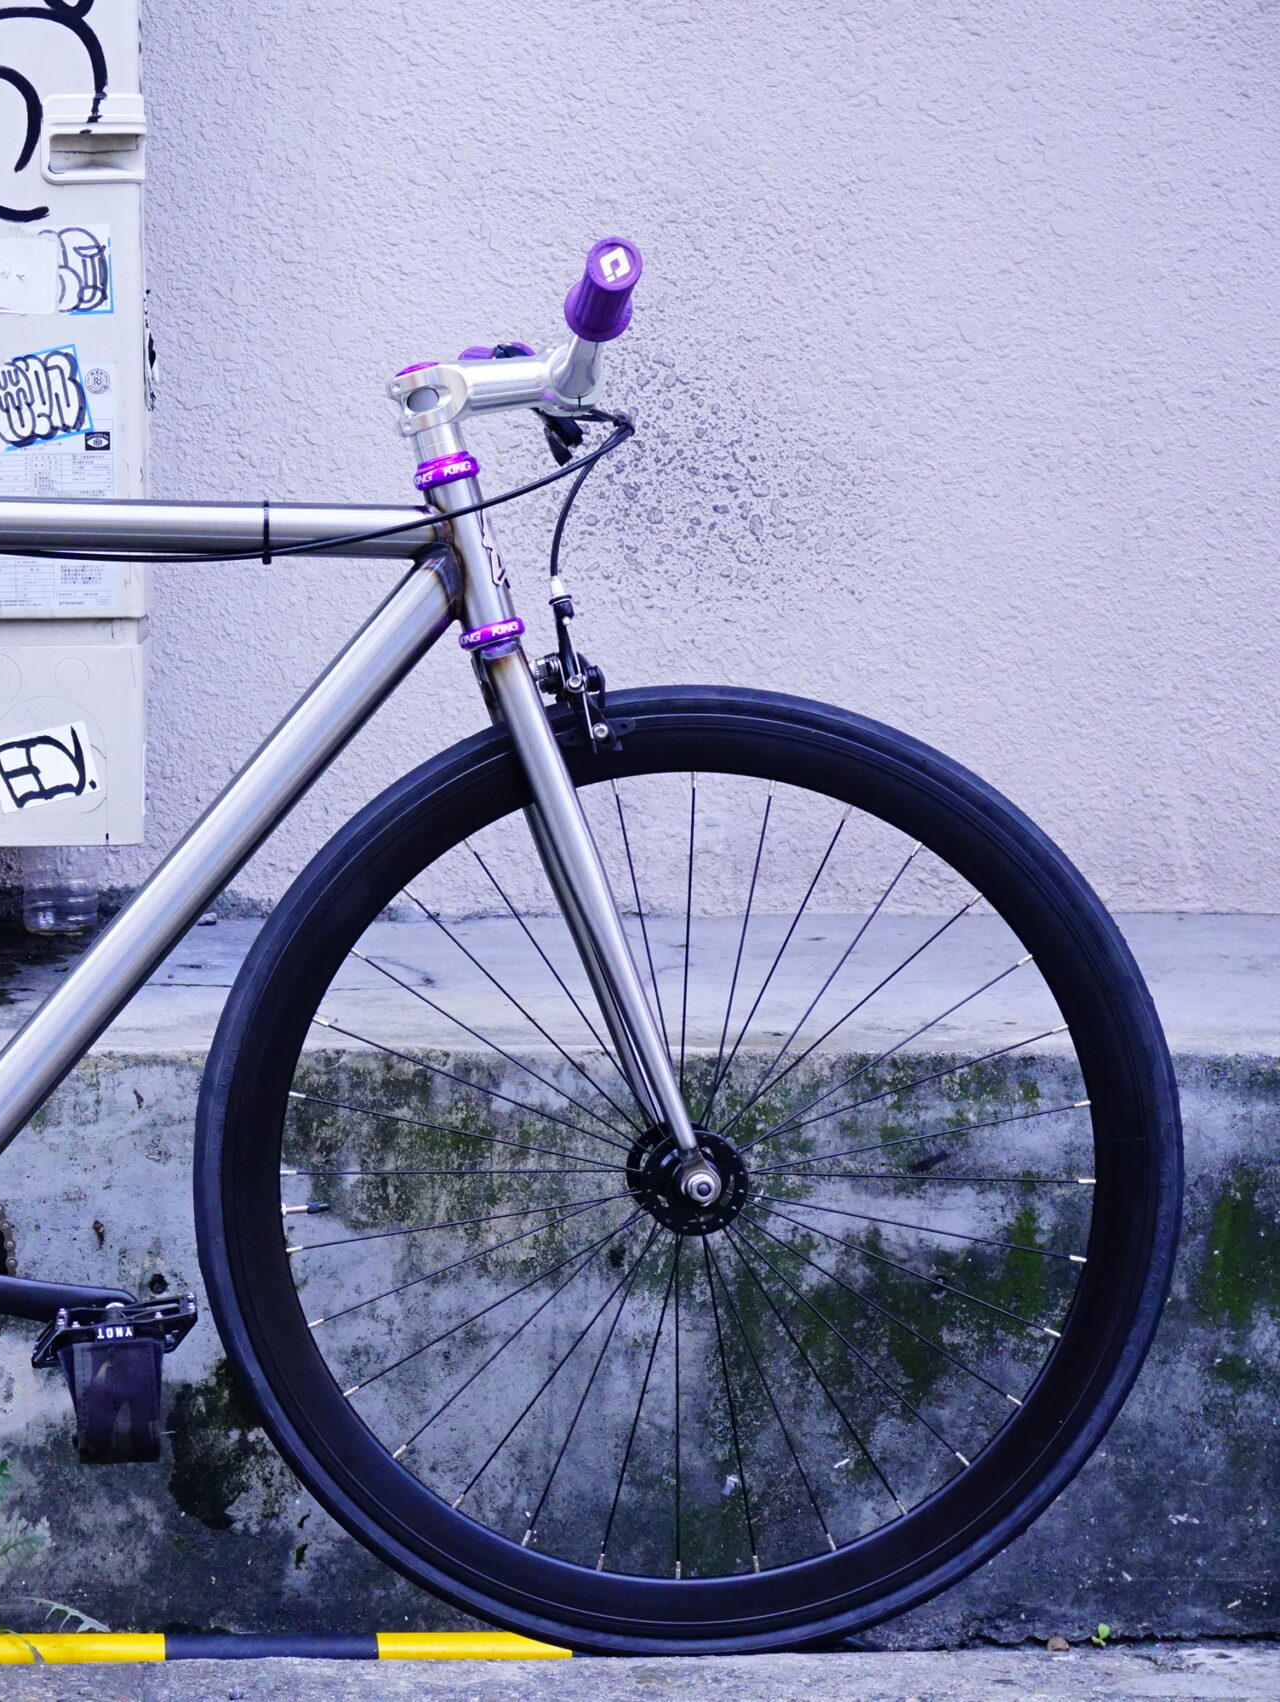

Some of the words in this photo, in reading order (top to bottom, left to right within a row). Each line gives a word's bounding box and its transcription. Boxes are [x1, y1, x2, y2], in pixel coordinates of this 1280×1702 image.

[443, 460, 472, 477] KING
[491, 620, 519, 637] KING
[97, 1327, 132, 1339] YNOT
